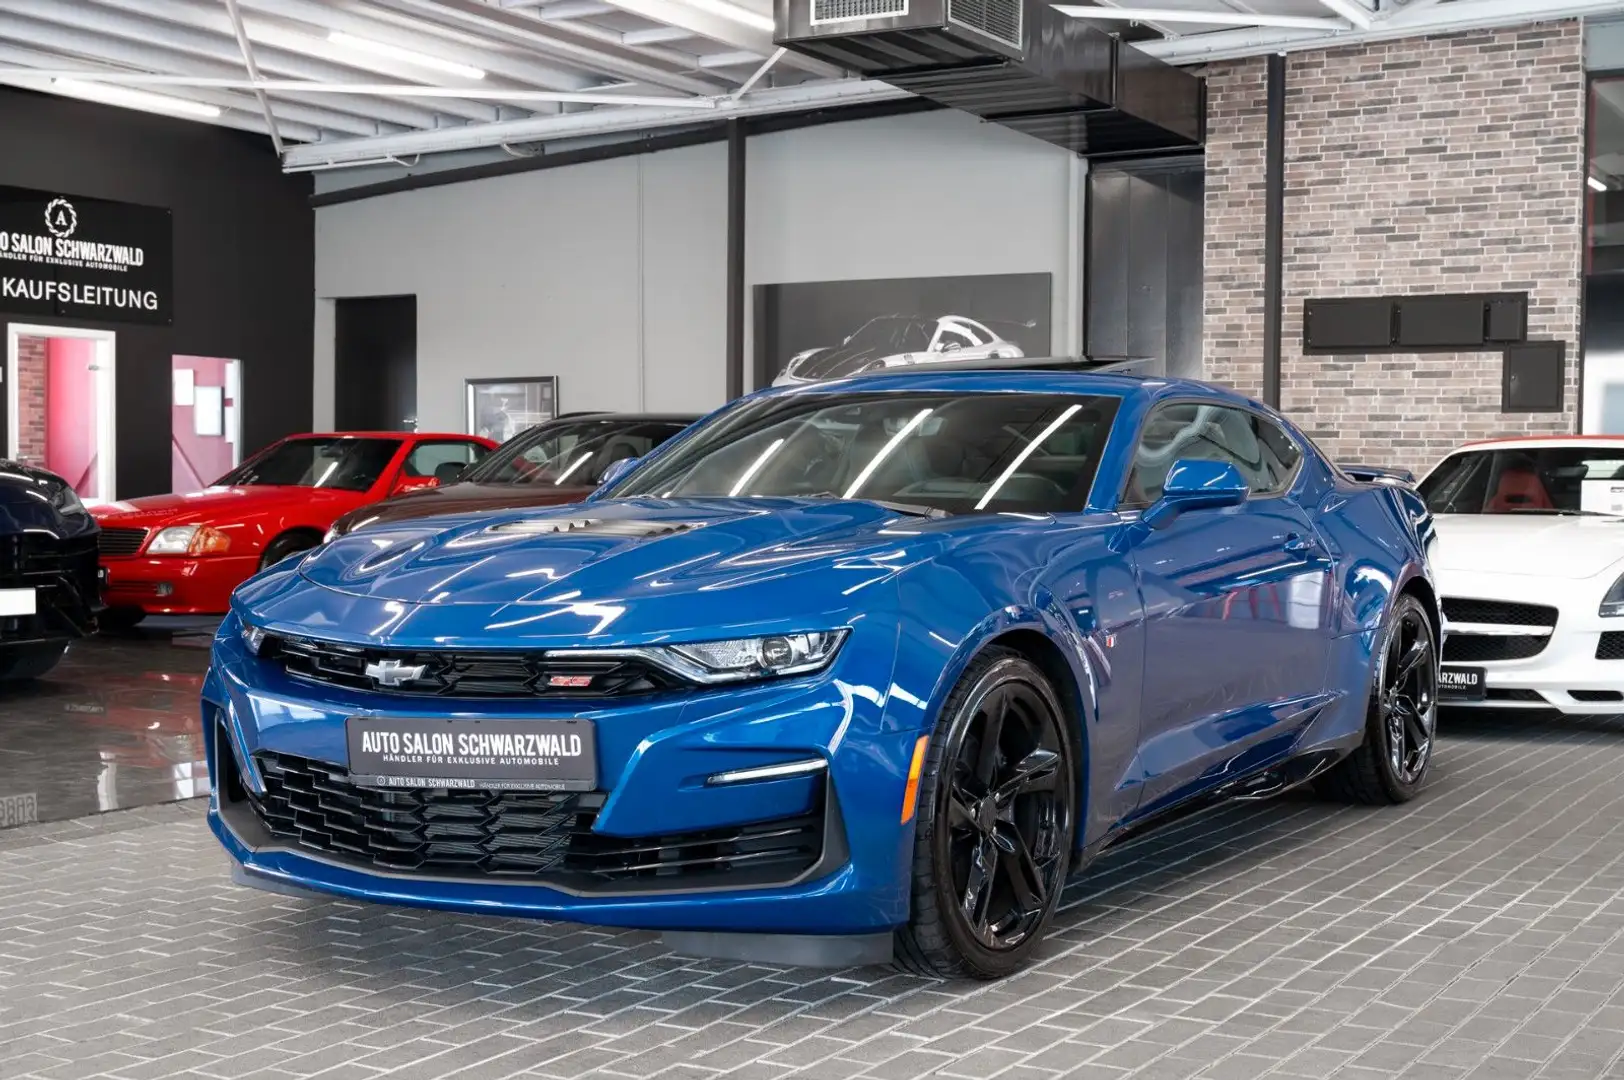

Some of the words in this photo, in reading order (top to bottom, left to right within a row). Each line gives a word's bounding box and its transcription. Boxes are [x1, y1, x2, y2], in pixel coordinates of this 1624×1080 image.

[11, 232, 52, 256] SALON
[56, 238, 144, 266] SCHWARZWALD
[46, 256, 83, 268] EXKLUSIVE
[85, 261, 128, 272] AUTOMOBILE
[2, 277, 158, 310] KAUFSLEITUNG
[362, 731, 400, 754] AUTO
[403, 732, 454, 755] SALON
[458, 733, 582, 757] SCHWARZWALD
[383, 754, 423, 763] HÄNDLER
[426, 755, 443, 764] FÜR
[447, 756, 496, 765] EXKLUSIVE
[500, 757, 560, 766] AUTOMOBILE
[388, 777, 405, 787] AUTO
[406, 777, 426, 787] SALON
[428, 778, 476, 788] SCHWARZWALD
